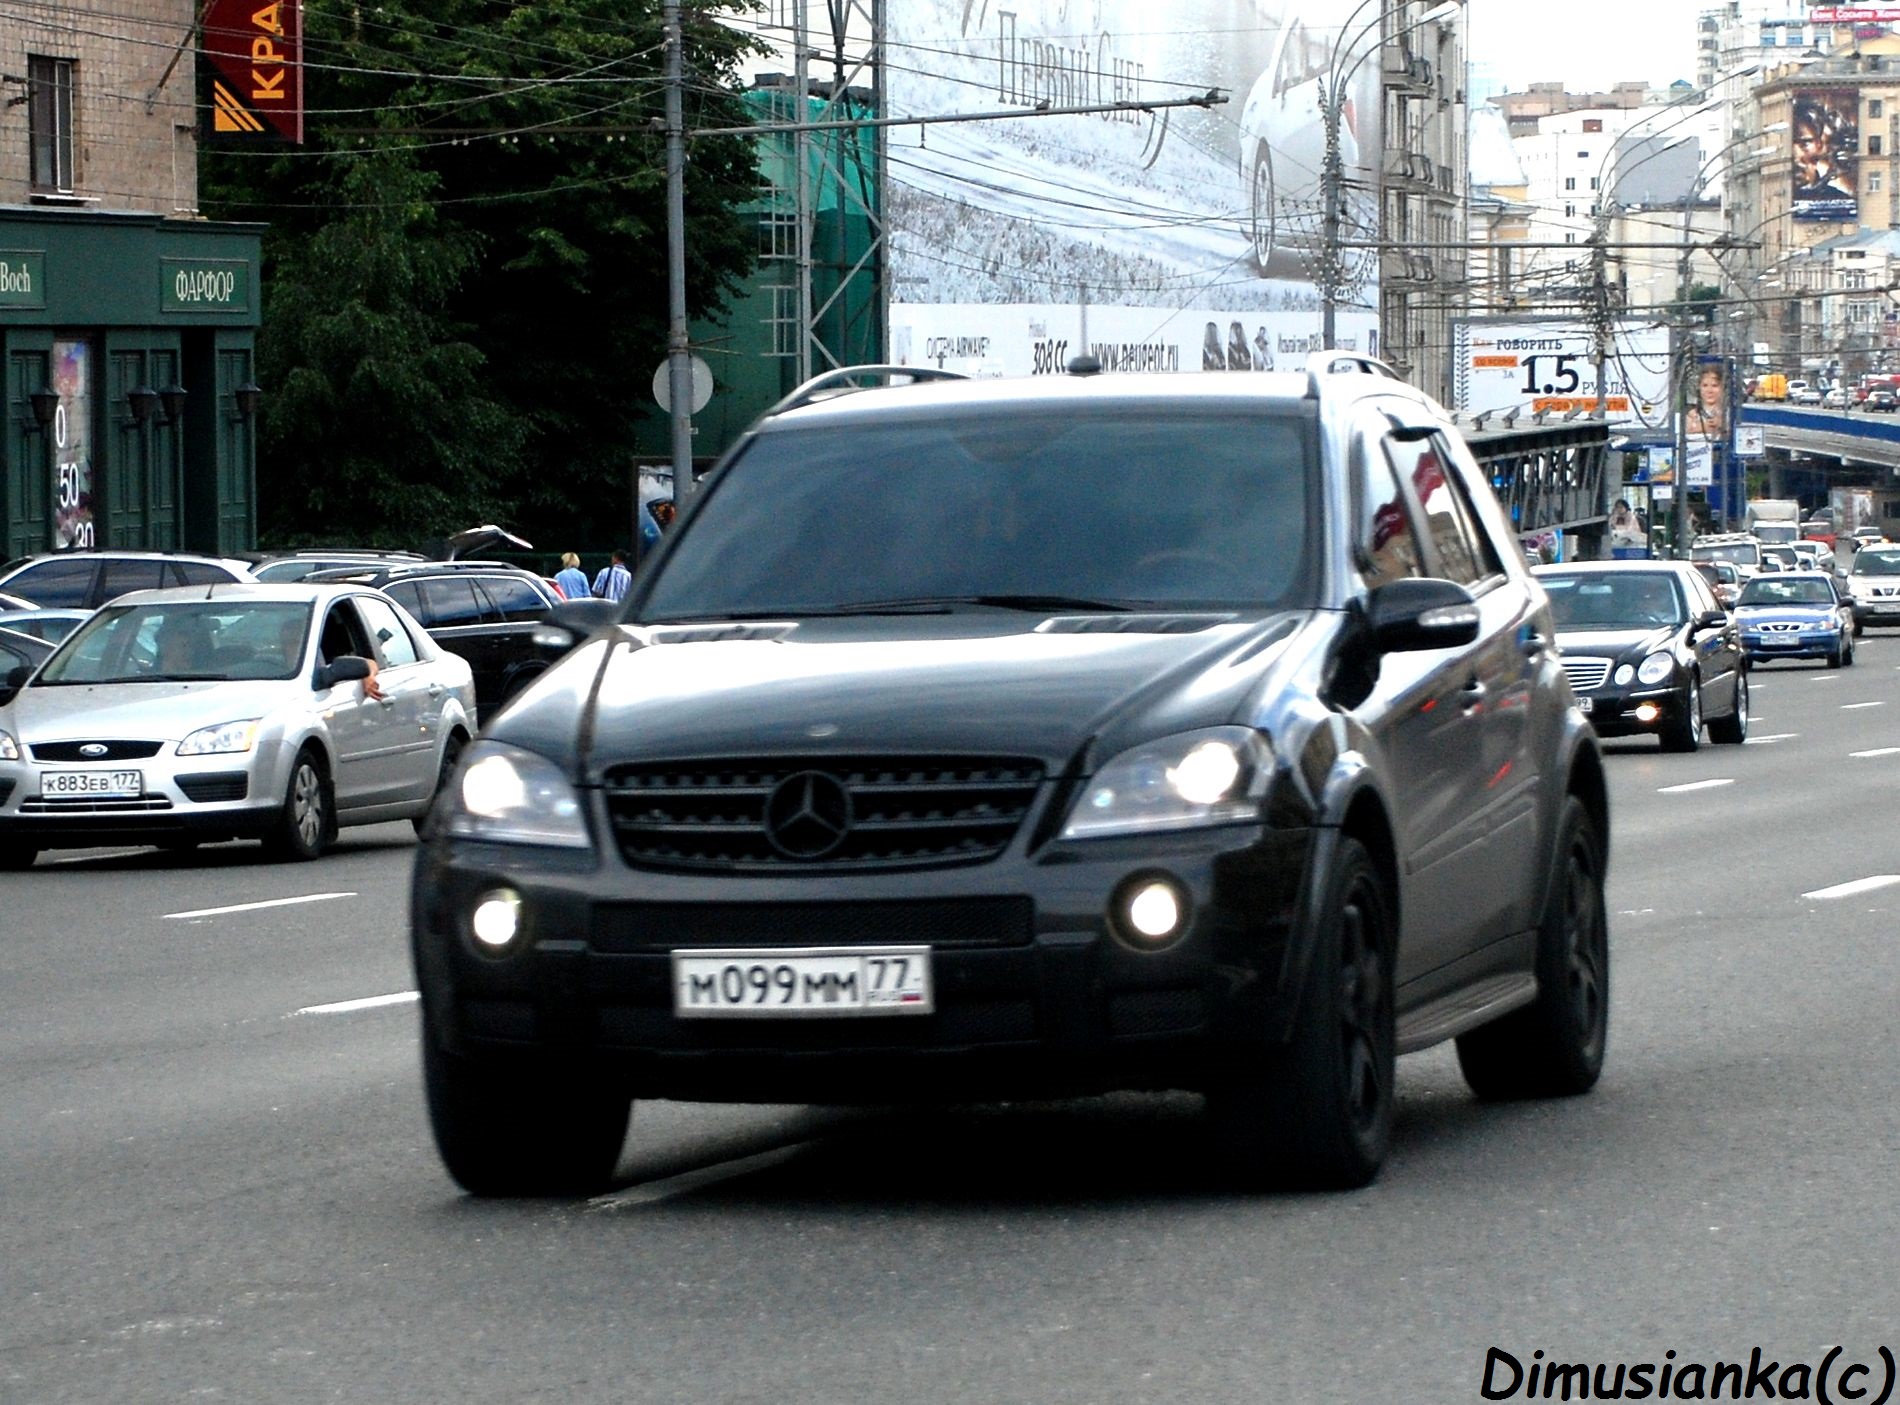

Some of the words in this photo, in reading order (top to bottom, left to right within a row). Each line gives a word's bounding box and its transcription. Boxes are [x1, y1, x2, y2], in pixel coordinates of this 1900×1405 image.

[0, 262, 31, 292] Boch
[175, 270, 235, 301] ФАРФОР
[1032, 338, 1054, 375] 308
[1091, 336, 1178, 372] www.peugeot.ru
[1496, 338, 1563, 350] ГОВОРИТЬ
[1521, 354, 1579, 394] 1.5
[60, 463, 79, 508] 50
[46, 775, 109, 792] К883ЕВ
[113, 773, 136, 786] 177
[690, 964, 859, 1004] М099ММ
[868, 959, 910, 989] 77
